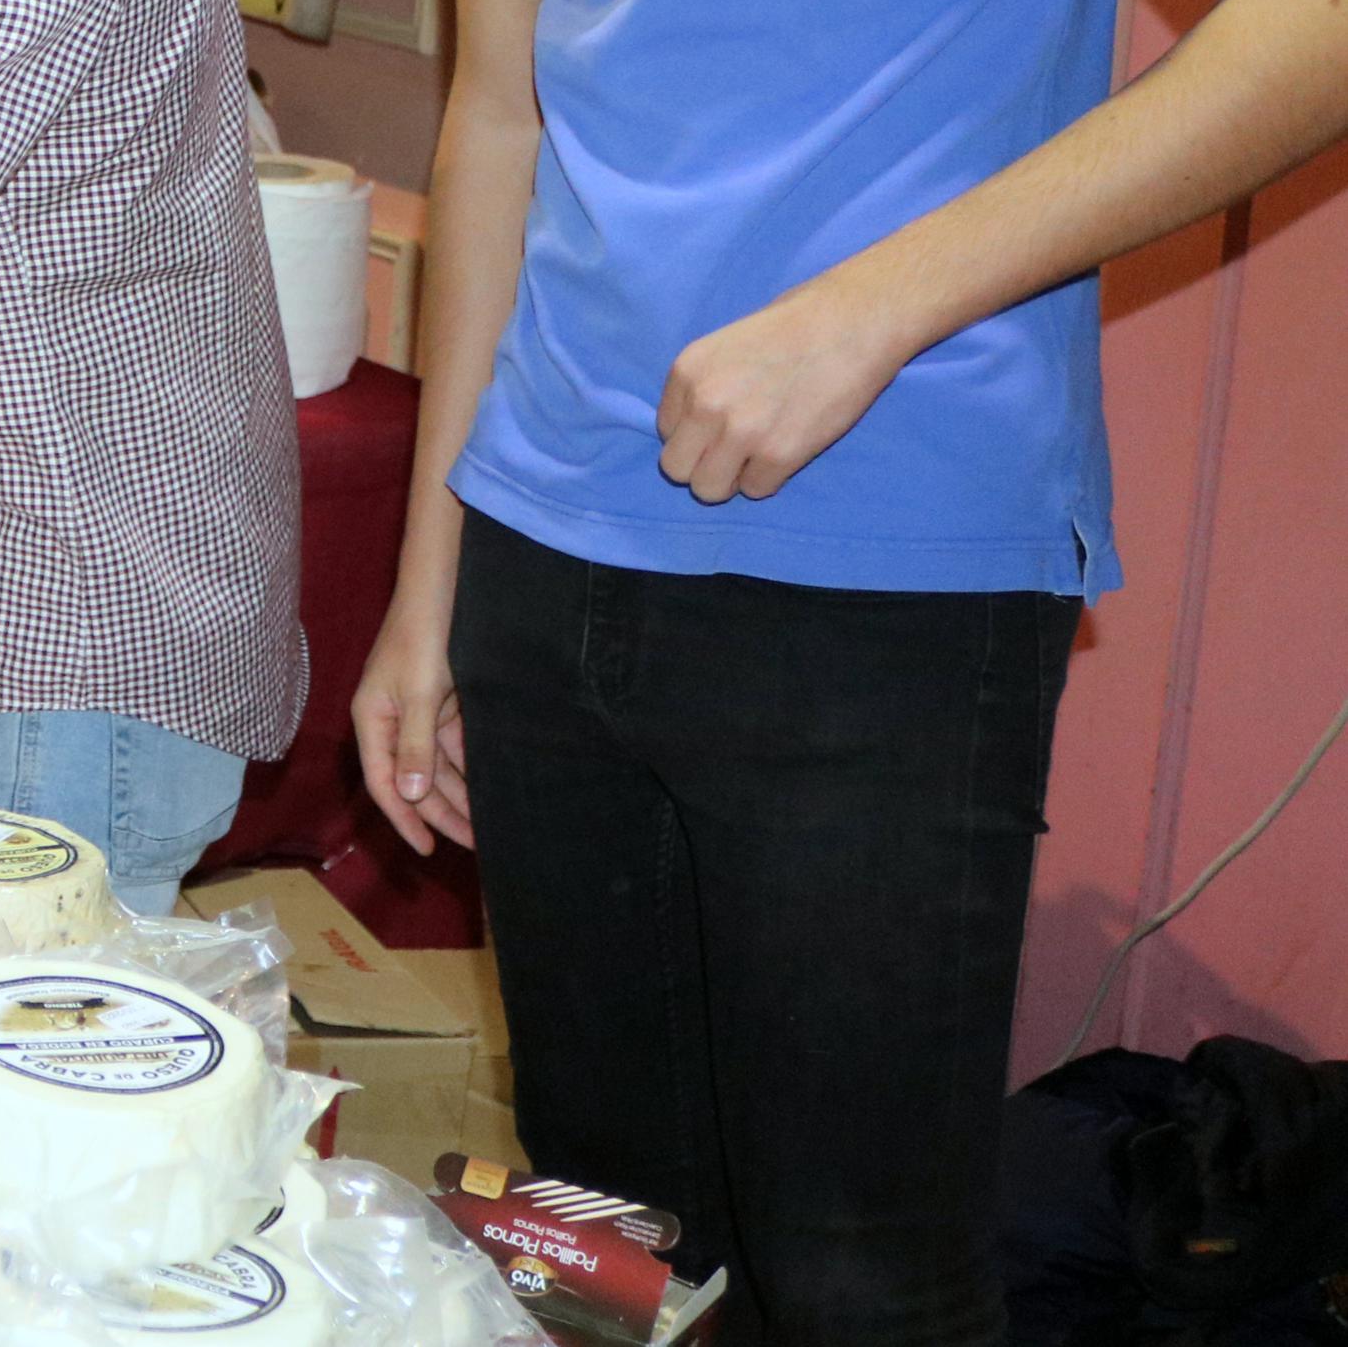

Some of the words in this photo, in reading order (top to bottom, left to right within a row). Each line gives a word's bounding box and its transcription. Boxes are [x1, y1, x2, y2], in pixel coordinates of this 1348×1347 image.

[15, 1042, 79, 1051] BODEGA
[83, 1041, 106, 1049] EN
[110, 1036, 176, 1048] CURADO
[19, 1053, 106, 1082] CABRA
[141, 1047, 196, 1082] QUESO
[483, 1223, 539, 1256] Planos
